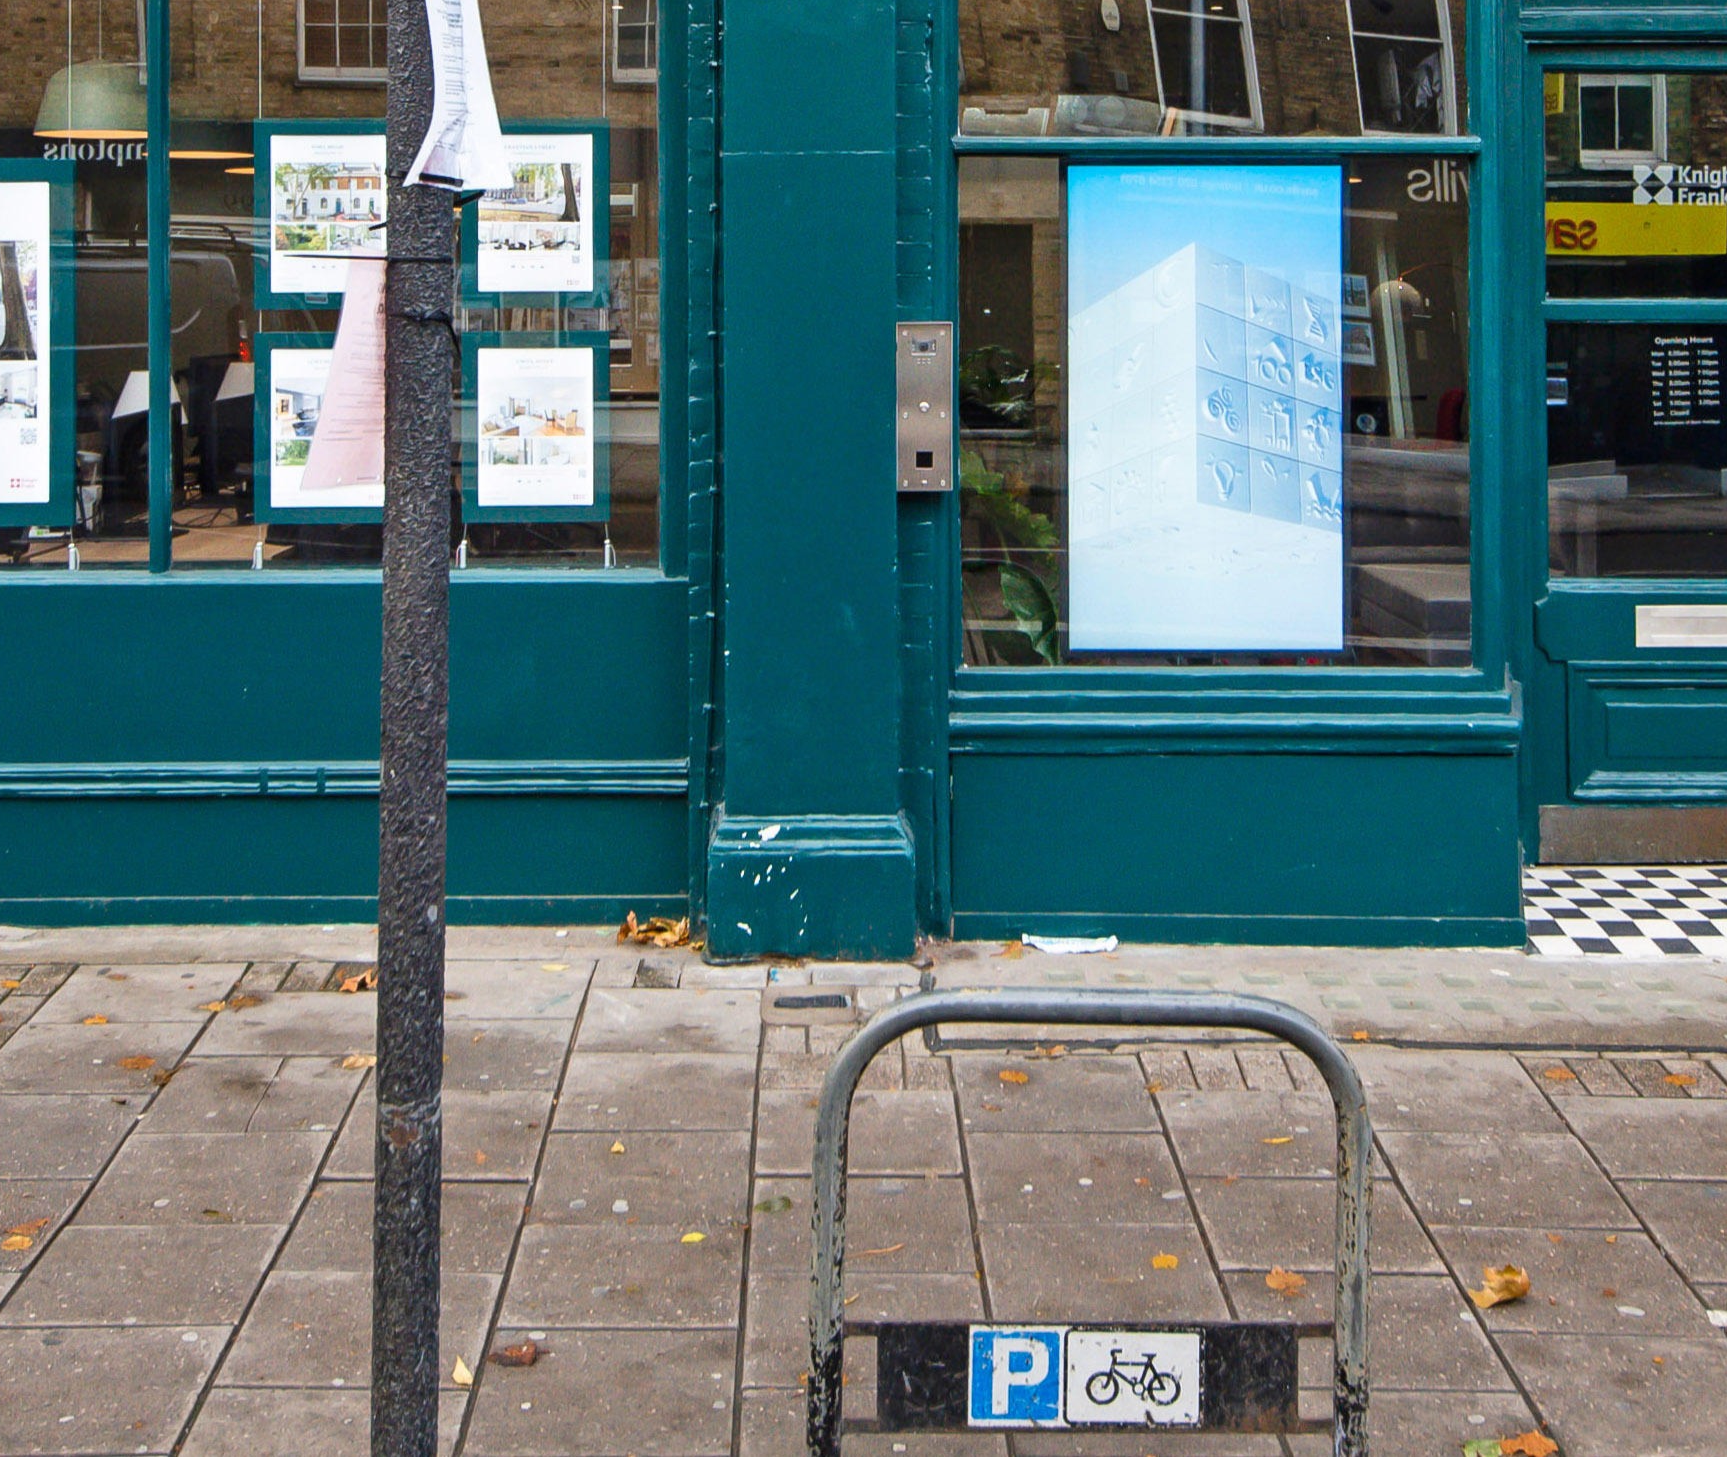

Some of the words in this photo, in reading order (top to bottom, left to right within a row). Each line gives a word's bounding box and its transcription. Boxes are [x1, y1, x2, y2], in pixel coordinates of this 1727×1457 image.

[1654, 337, 1688, 346] Opening
[1689, 336, 1714, 344] Hours
[991, 1336, 1050, 1416] P
